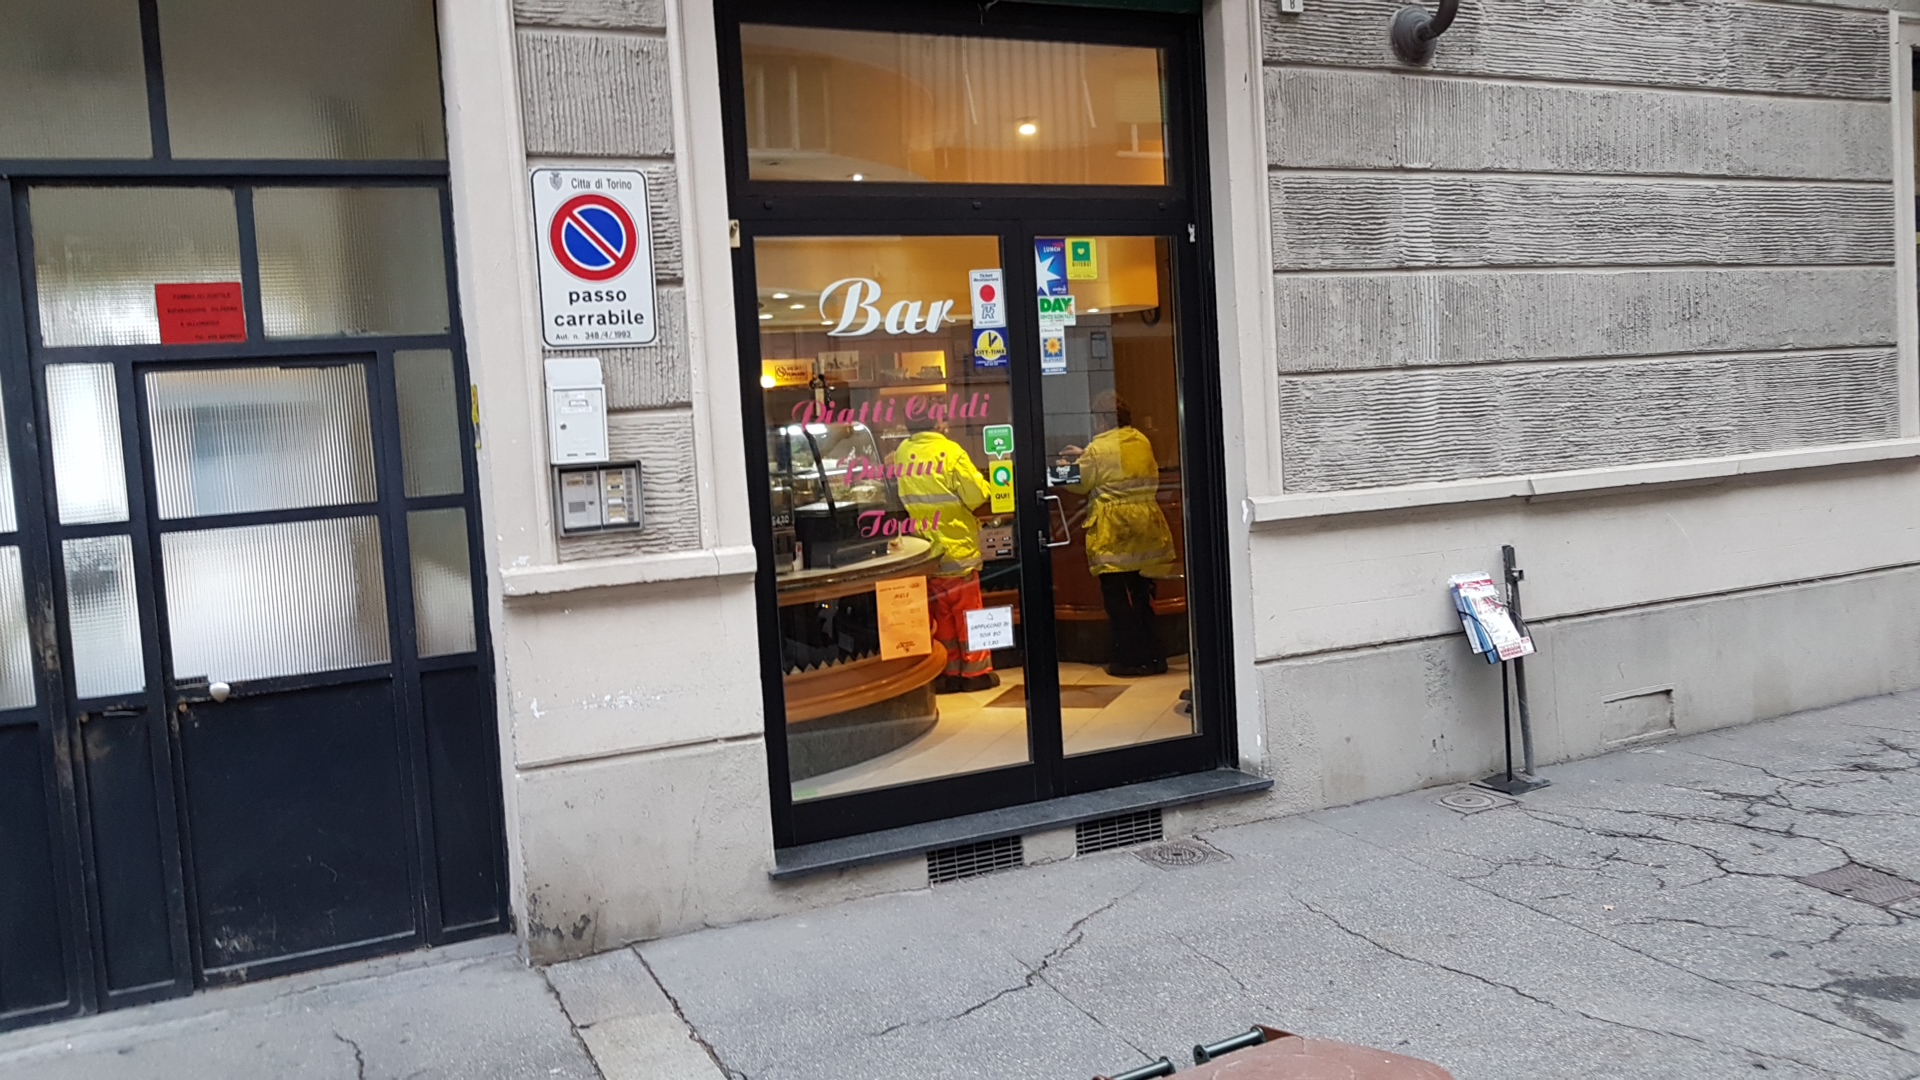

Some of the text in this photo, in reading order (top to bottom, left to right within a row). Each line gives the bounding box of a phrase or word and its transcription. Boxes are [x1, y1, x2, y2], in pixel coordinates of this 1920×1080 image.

[595, 177, 603, 189] di
[606, 178, 632, 190] Torino
[569, 289, 627, 306] passo
[1040, 297, 1073, 313] DAY
[819, 277, 956, 337] Bar
[554, 309, 645, 326] carrabile
[791, 391, 991, 432] Piatti Caldi
[836, 451, 947, 487] Panini
[857, 509, 942, 539] Toast
[971, 622, 1002, 631] CAPPUCCINO
